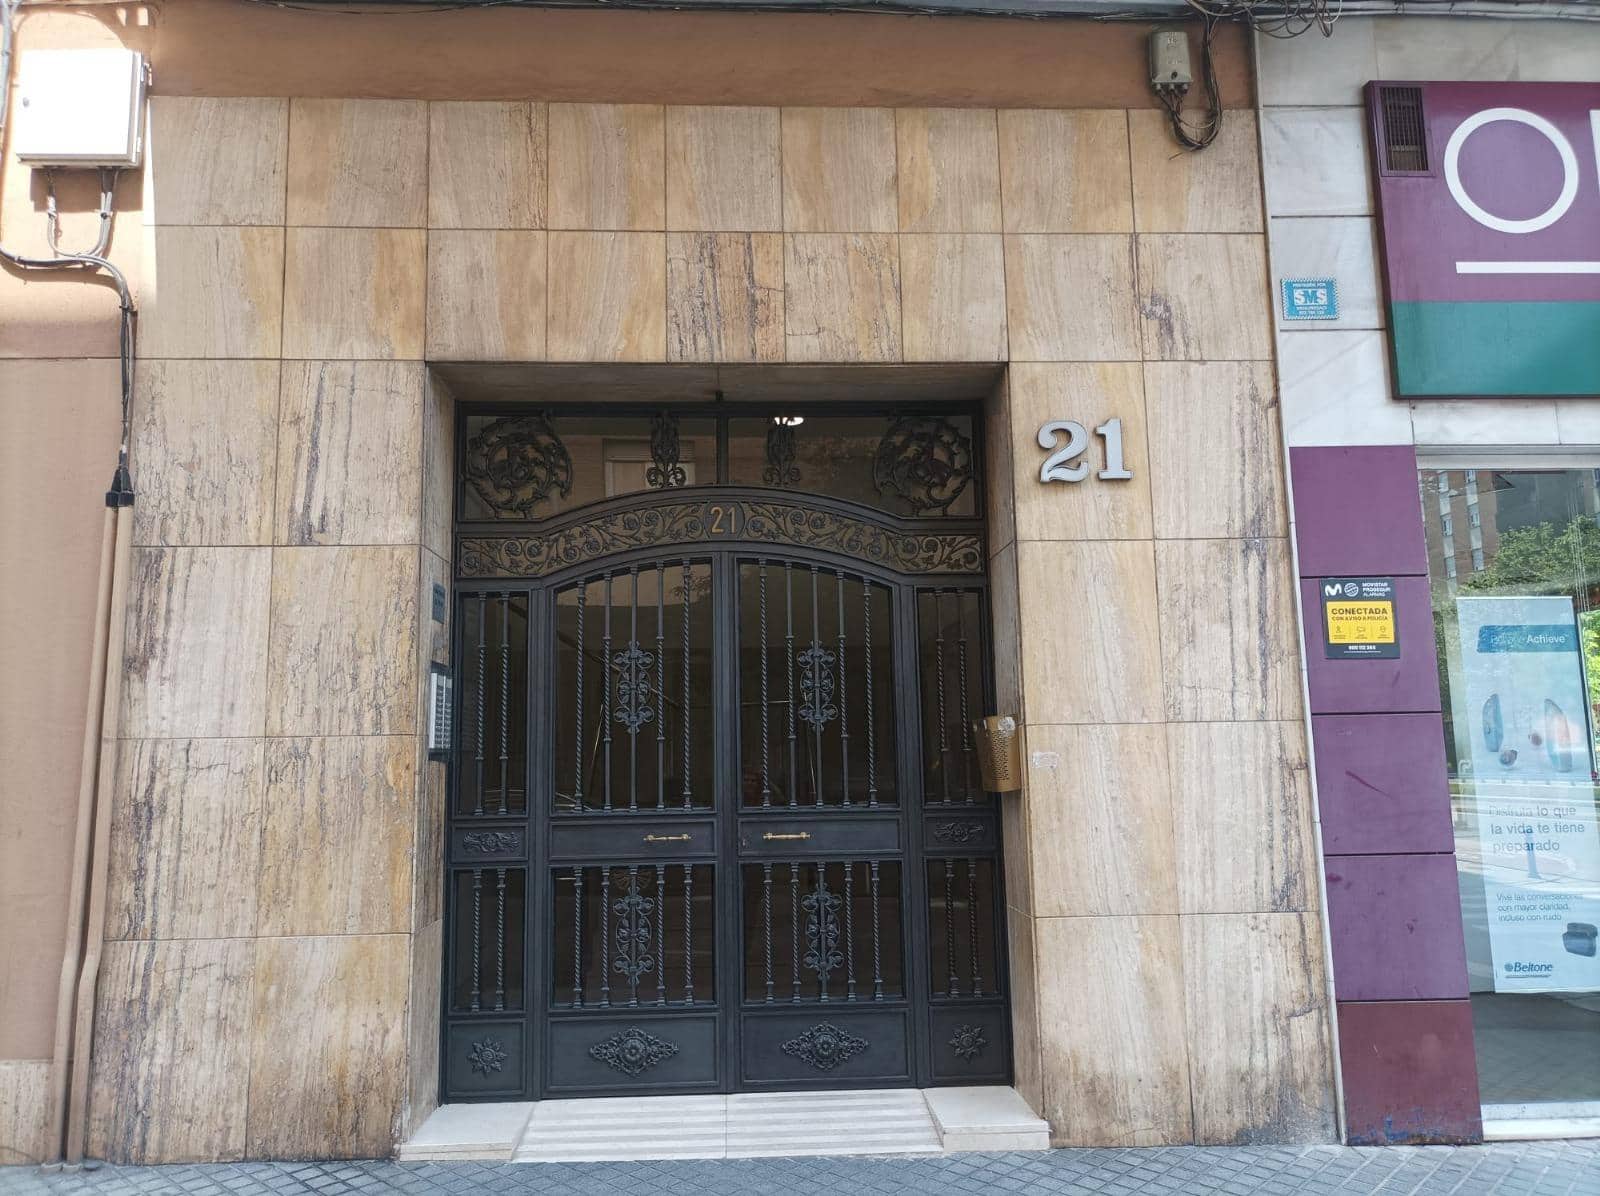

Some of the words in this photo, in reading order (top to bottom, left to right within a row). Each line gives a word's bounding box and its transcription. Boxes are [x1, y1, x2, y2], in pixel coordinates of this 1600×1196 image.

[1294, 289, 1327, 306] SMS
[1037, 418, 1134, 483] 21
[711, 506, 736, 534] 21
[1331, 607, 1388, 615] CONECTADA
[1537, 805, 1548, 816] lo
[1553, 807, 1577, 818] que
[1491, 823, 1502, 834] la
[1506, 823, 1533, 834] vida
[1537, 823, 1550, 834] te
[1554, 822, 1585, 833] tiene
[1493, 840, 1560, 853] preparado
[1514, 904, 1537, 912] mayor
[1498, 913, 1525, 921] incluso
[1513, 961, 1554, 972] Beltone
